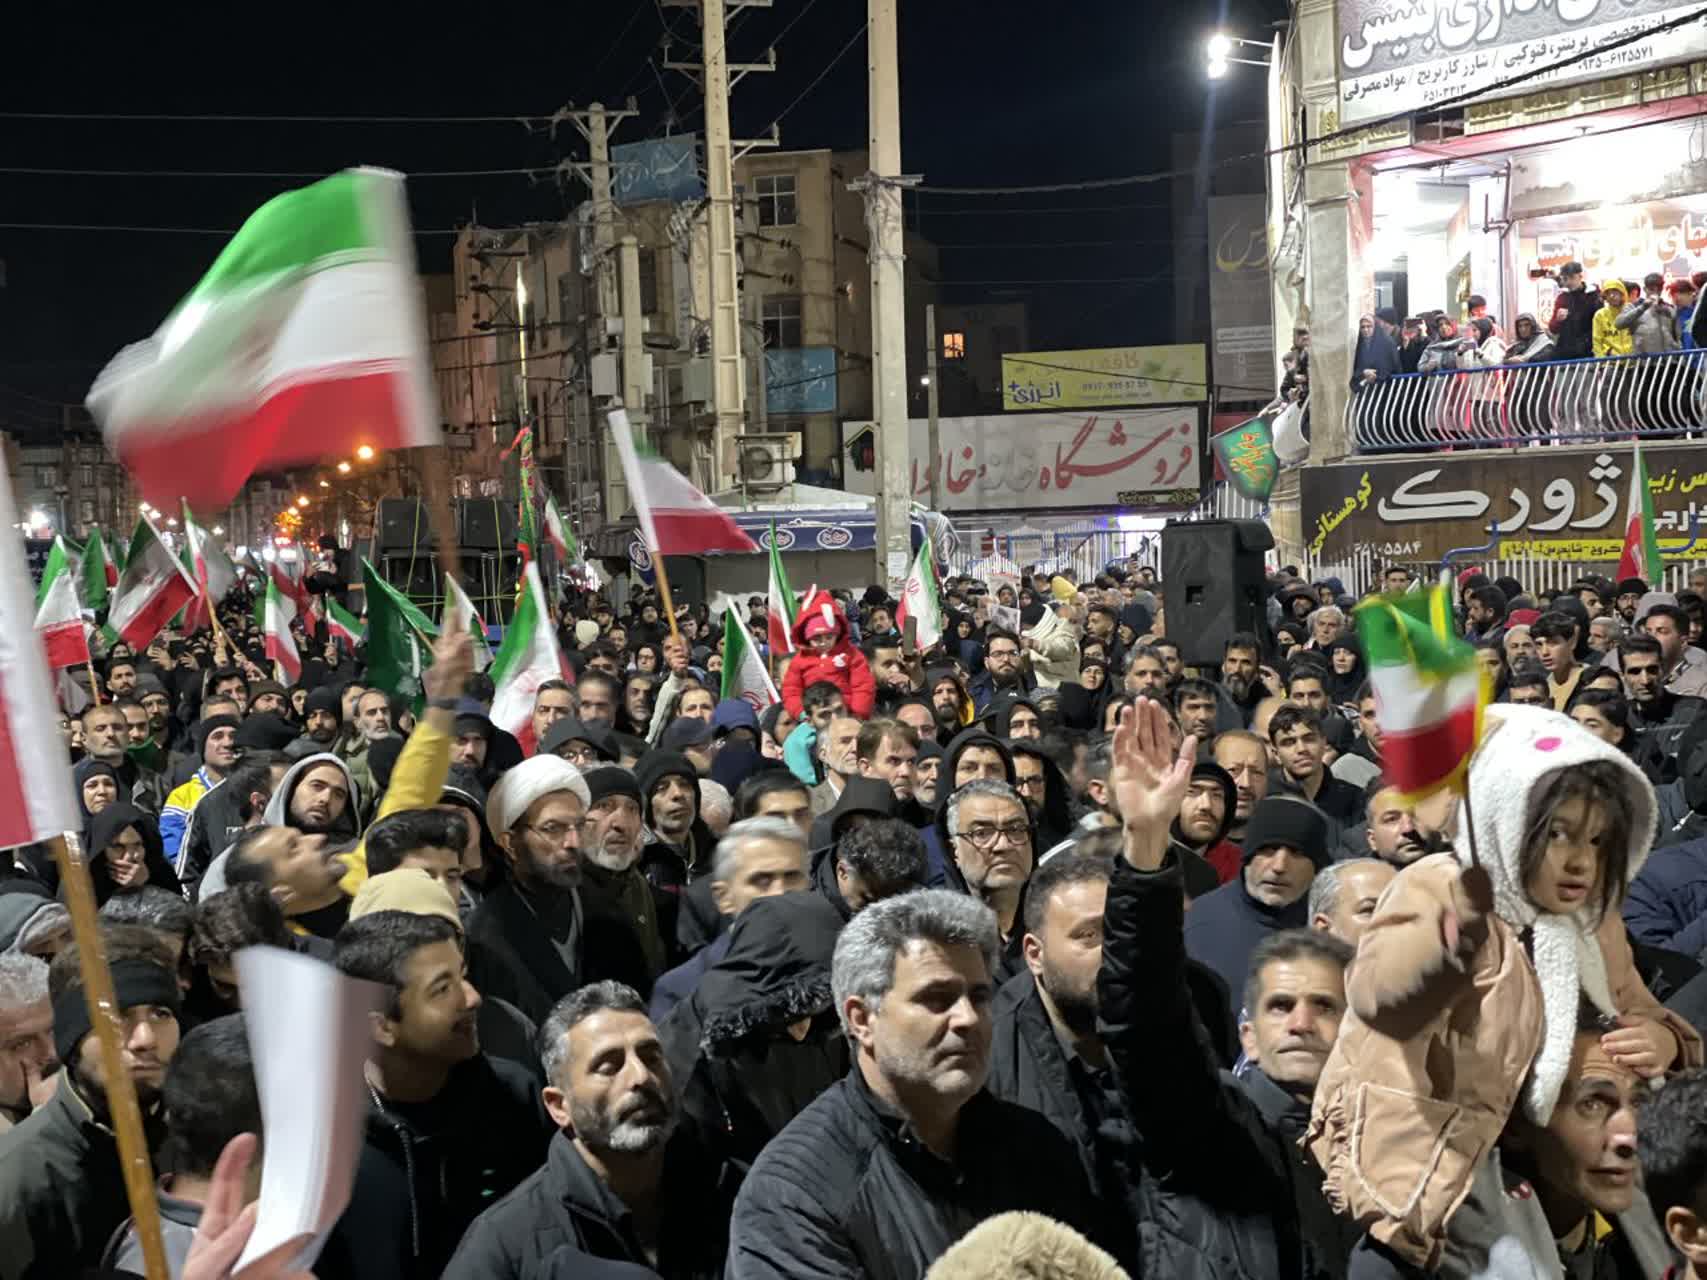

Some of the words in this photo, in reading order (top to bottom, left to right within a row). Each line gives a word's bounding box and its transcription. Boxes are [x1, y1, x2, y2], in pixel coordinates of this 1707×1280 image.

[1039, 416, 1192, 492] فروشگاه
[1377, 453, 1622, 532] ژورک
[1308, 471, 1371, 556] کوهستانی
